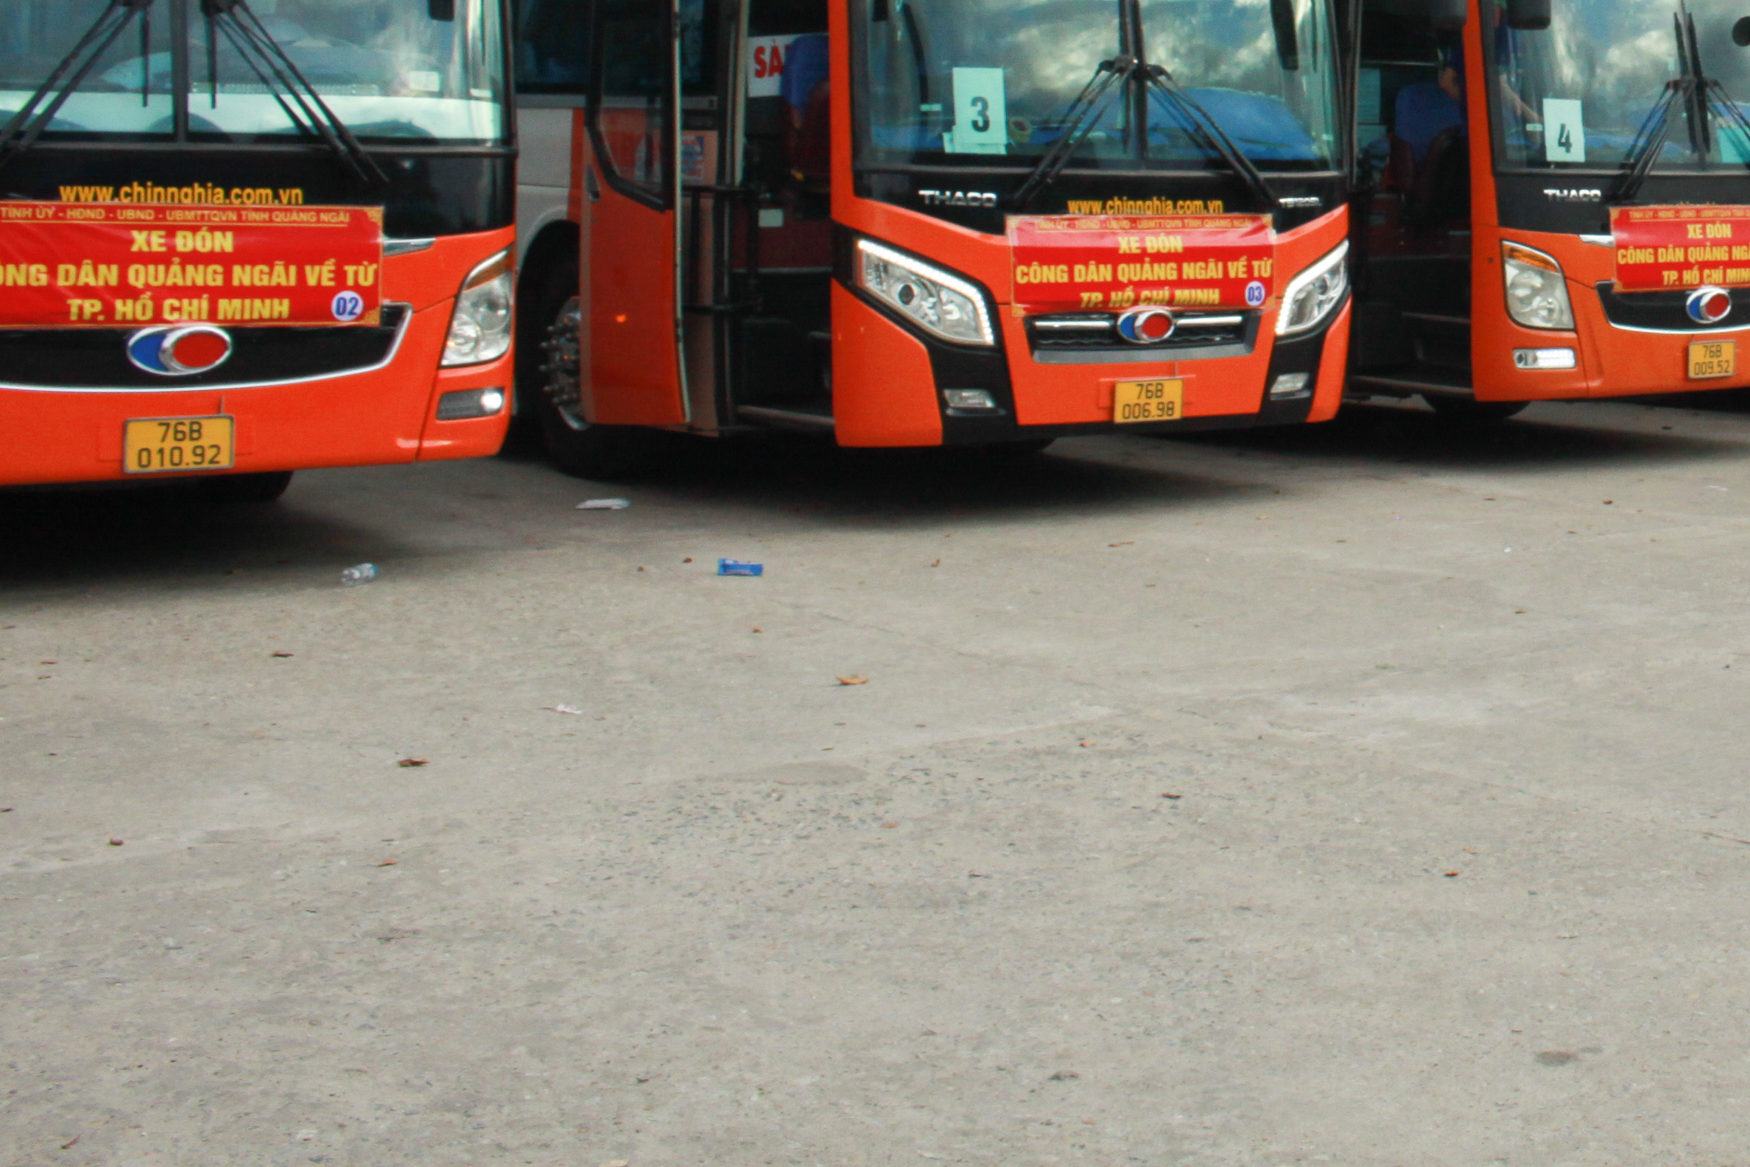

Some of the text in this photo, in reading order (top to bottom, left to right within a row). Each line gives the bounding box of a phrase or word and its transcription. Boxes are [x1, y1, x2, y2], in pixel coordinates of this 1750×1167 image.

[754, 38, 790, 79] SÀ
[971, 95, 990, 133] 3
[1557, 122, 1573, 154] 4
[59, 181, 304, 205] www.chinnghia.com.vn
[918, 189, 997, 207] THACO
[1543, 189, 1601, 202] THACO
[116, 209, 155, 220] UBND
[130, 226, 234, 253] XE ĐÓN
[1687, 221, 1732, 239] XE ĐÓN
[1118, 232, 1183, 254] XE ĐÓN
[1617, 246, 1654, 264] CÔNG
[1657, 244, 1684, 263] DÂN
[1688, 242, 1729, 263] QUẢNG
[0, 257, 378, 289] NG DÂN QUẢNG NGÃI VỀ TỪ
[1016, 255, 1272, 284] CÔNG DÂN QUẢNG NGÃI VỀ TỪ
[1662, 270, 1679, 285] TP.
[1683, 265, 1700, 285] HỒ
[1703, 266, 1723, 283] CHÍ
[1080, 286, 1220, 308] TP. HỒ CHÍ MINH
[1246, 285, 1263, 303] 03
[67, 291, 290, 321] TP. HỒ CHÍ MINH
[334, 296, 359, 316] 02
[1702, 344, 1722, 359] 76B
[1693, 360, 1731, 375] 009.52
[1135, 383, 1164, 401] 76B
[1122, 402, 1175, 420] 006.98
[157, 422, 202, 443] 76B
[137, 445, 222, 469] 010.92
